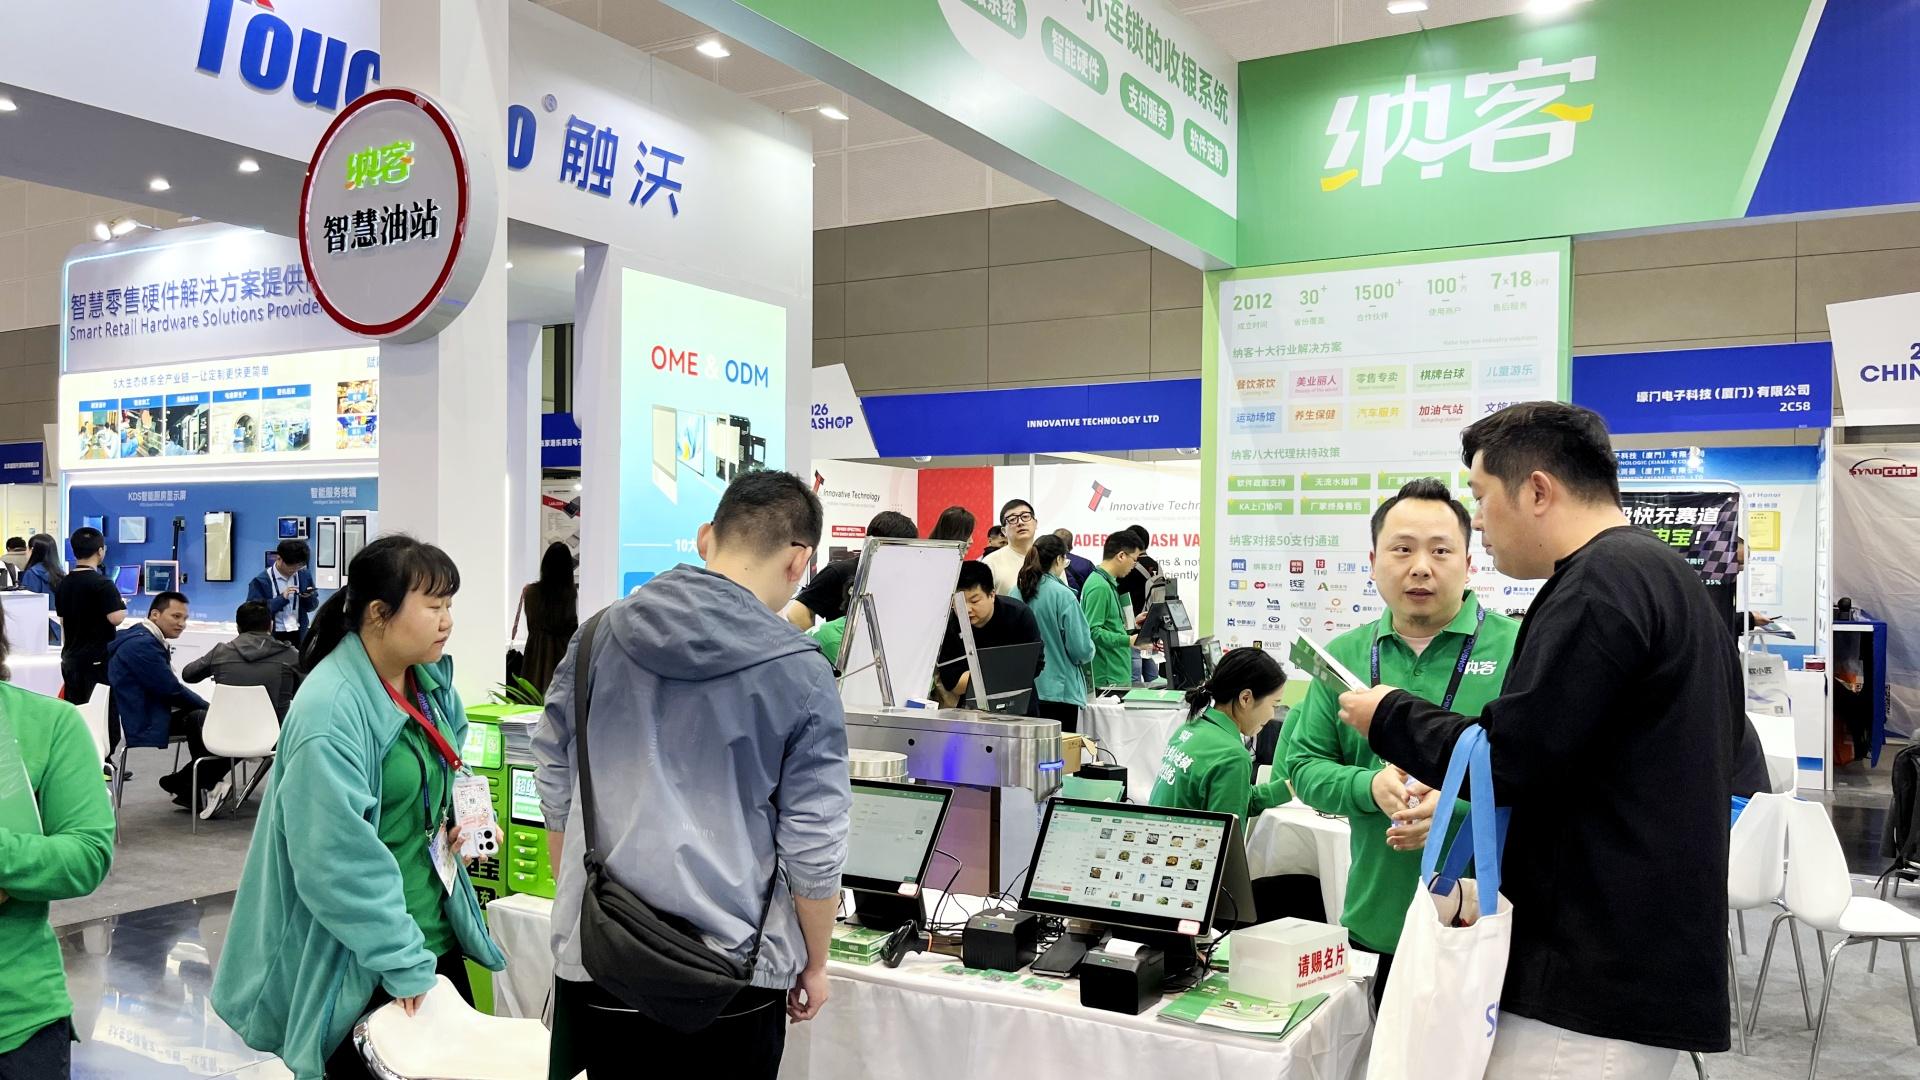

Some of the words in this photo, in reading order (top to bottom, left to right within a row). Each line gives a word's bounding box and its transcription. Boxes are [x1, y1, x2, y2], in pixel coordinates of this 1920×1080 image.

[1051, 27, 1100, 88] 智能硬件
[1127, 84, 1168, 132] 支付服务
[1320, 55, 1597, 192] 纳客
[1190, 127, 1224, 171] 软件定制
[559, 114, 685, 218] 触沃
[323, 198, 440, 254] 智慧油站
[70, 264, 311, 321] 智慧零售硬件解决方案提供
[1233, 293, 1273, 311] 2012
[69, 324, 103, 341] Smart
[105, 318, 137, 337] Retail
[140, 313, 200, 334] Hardware
[202, 306, 263, 328] Solutions
[1356, 312, 1390, 322] 合作伙伴
[1237, 320, 1268, 330] 成立时间
[1232, 341, 1343, 359] 纳客十大行业解决方案
[651, 345, 699, 377] OME
[725, 359, 769, 388] ODM
[1486, 364, 1533, 377] 儿童游乐
[1296, 375, 1337, 387] 美业丽人
[1356, 371, 1398, 384] 零售专卖
[1420, 368, 1465, 381] 棋牌台球
[1236, 378, 1276, 390] 餐饮茶饮
[1357, 407, 1400, 418] 汽车服务
[1418, 404, 1464, 417] 加油气站
[1779, 401, 1811, 412] 2C58
[1027, 418, 1080, 428] INNOVATIVE
[1082, 415, 1141, 426] TECHNOLOGY
[1143, 414, 1160, 423] LTD
[1236, 411, 1276, 423] 运动场馆
[1295, 409, 1336, 421] 养生保健
[1231, 447, 1341, 461] 纳客八大代理扶持政策
[310, 487, 357, 499] 智能服务终端
[823, 489, 851, 499] Innovative
[852, 490, 880, 502] Technology
[1109, 501, 1165, 512] Innovative
[1229, 534, 1340, 547] 纳客对接50支付通道
[1297, 942, 1345, 978] 请赐名片
